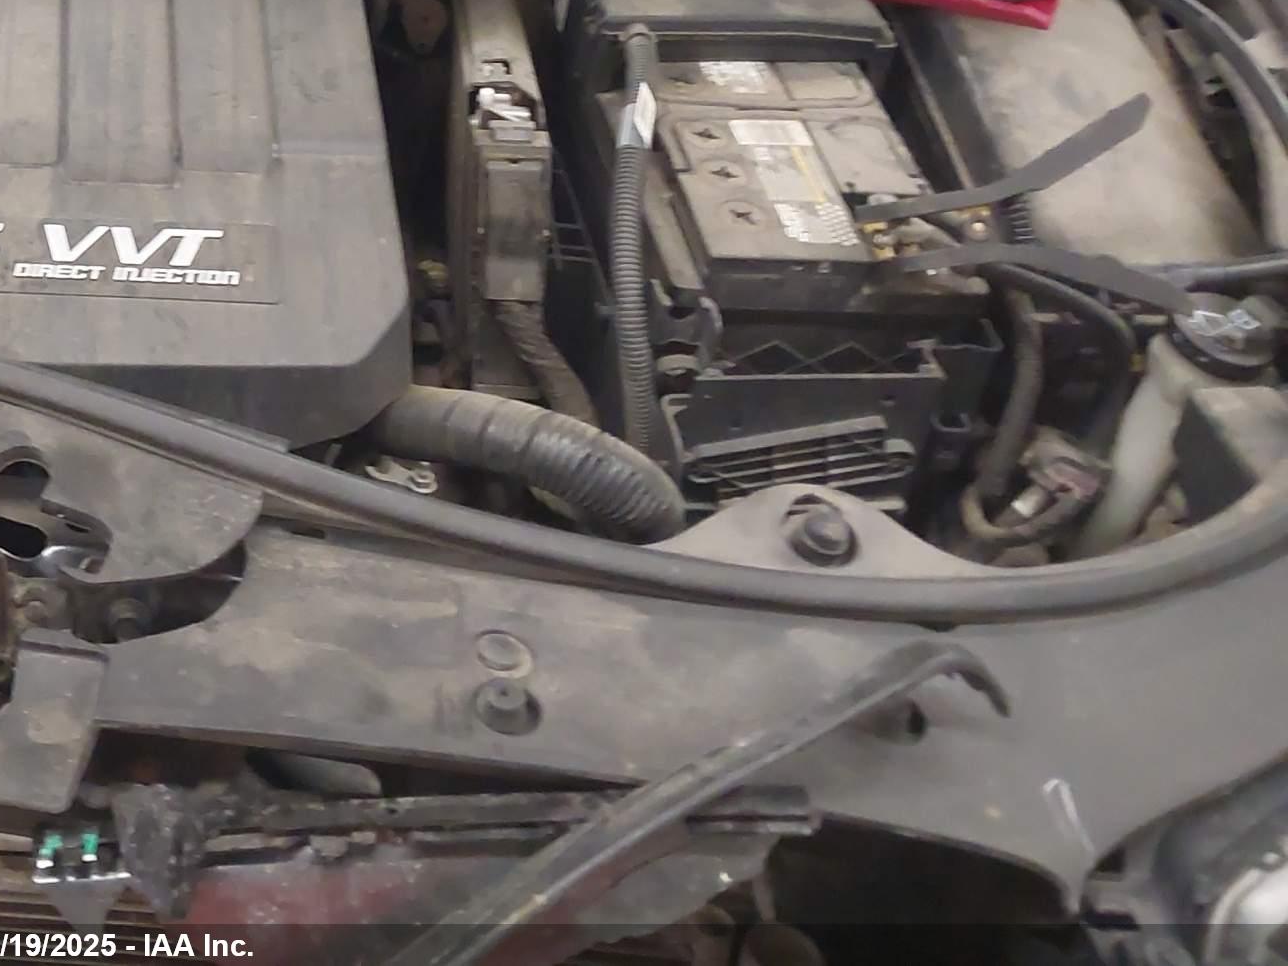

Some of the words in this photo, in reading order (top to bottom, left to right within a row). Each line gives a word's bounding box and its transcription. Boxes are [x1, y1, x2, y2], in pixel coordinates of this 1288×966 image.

[43, 223, 224, 267] VVT
[12, 262, 106, 281] DIRECT
[112, 266, 241, 286] INJECTION
